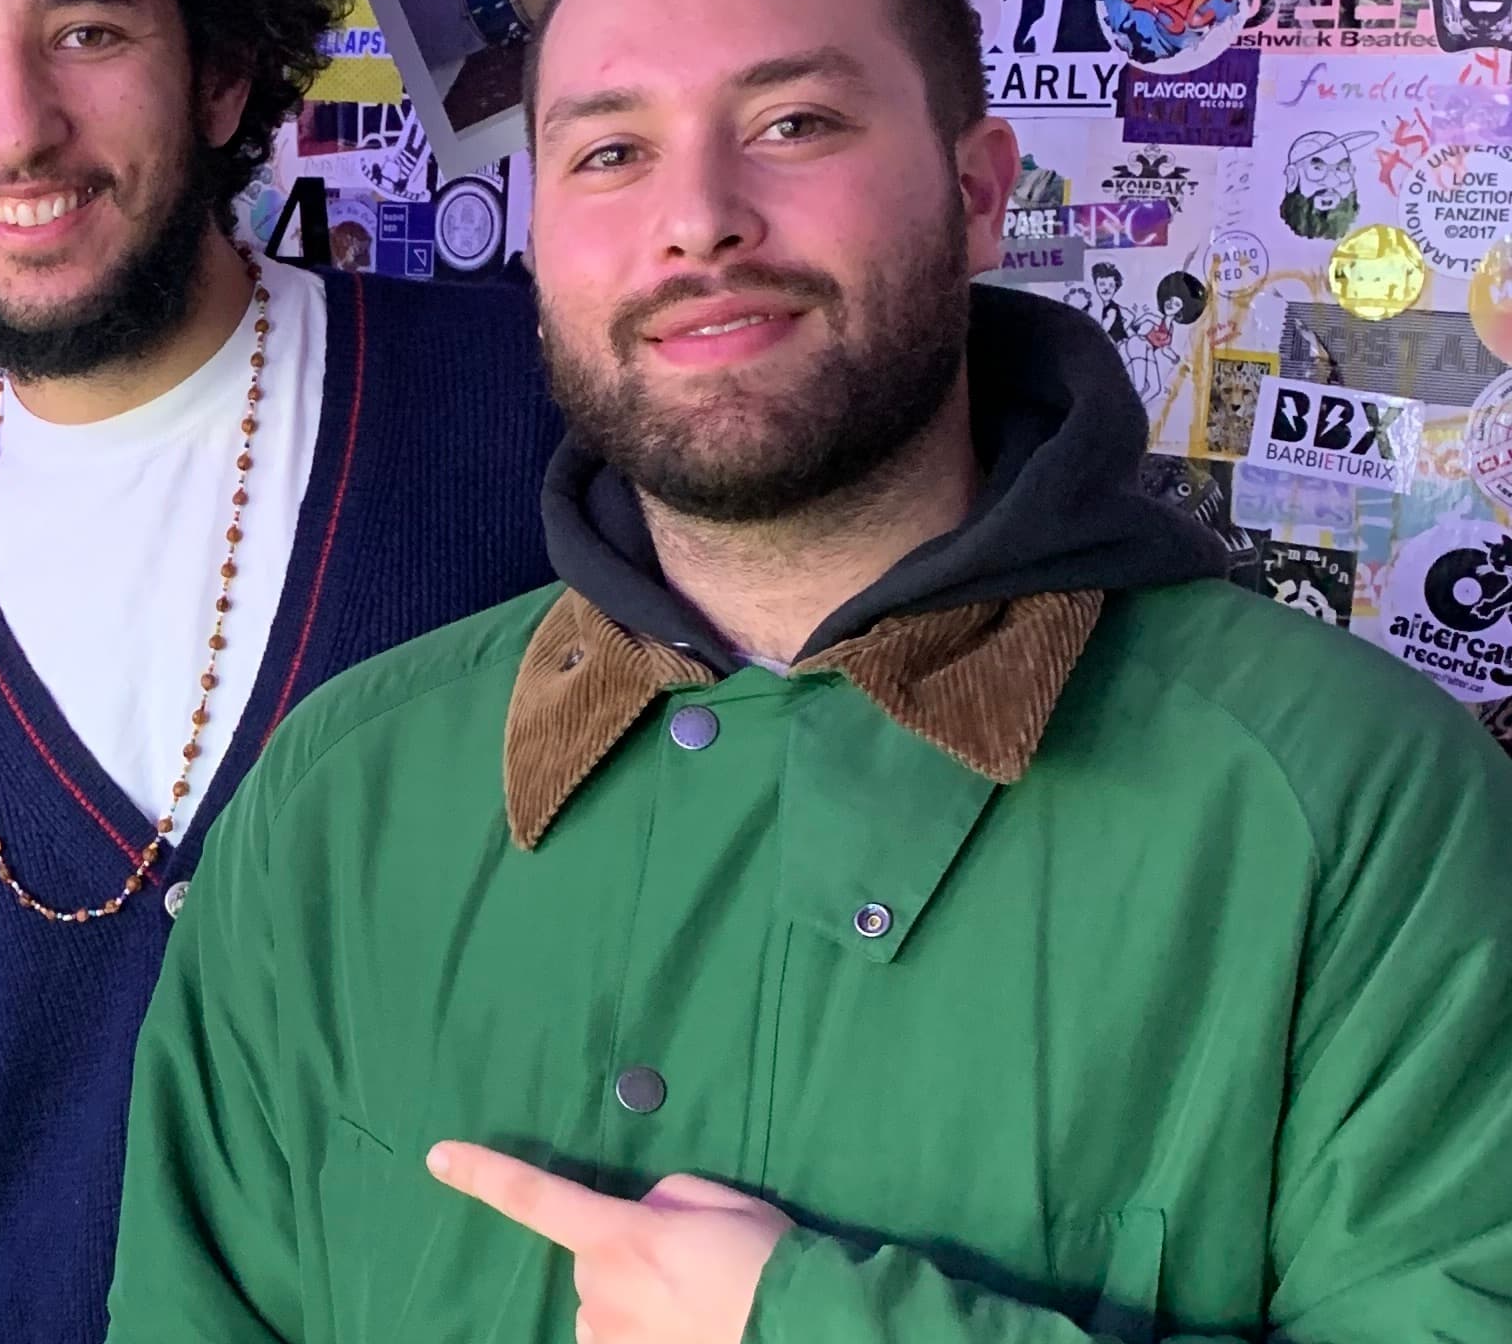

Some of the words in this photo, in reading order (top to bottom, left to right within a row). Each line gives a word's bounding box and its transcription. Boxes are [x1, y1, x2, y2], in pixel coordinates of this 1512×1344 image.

[1133, 81, 1248, 101] PLAYGROUND
[1112, 175, 1200, 197] KOMPAKT
[1452, 171, 1500, 187] LOVE
[1433, 206, 1511, 224] FANZINE
[1214, 268, 1243, 282] RED
[1270, 386, 1405, 460] BBX
[1266, 441, 1397, 483] BARBIETURIX
[1403, 643, 1489, 682] records
